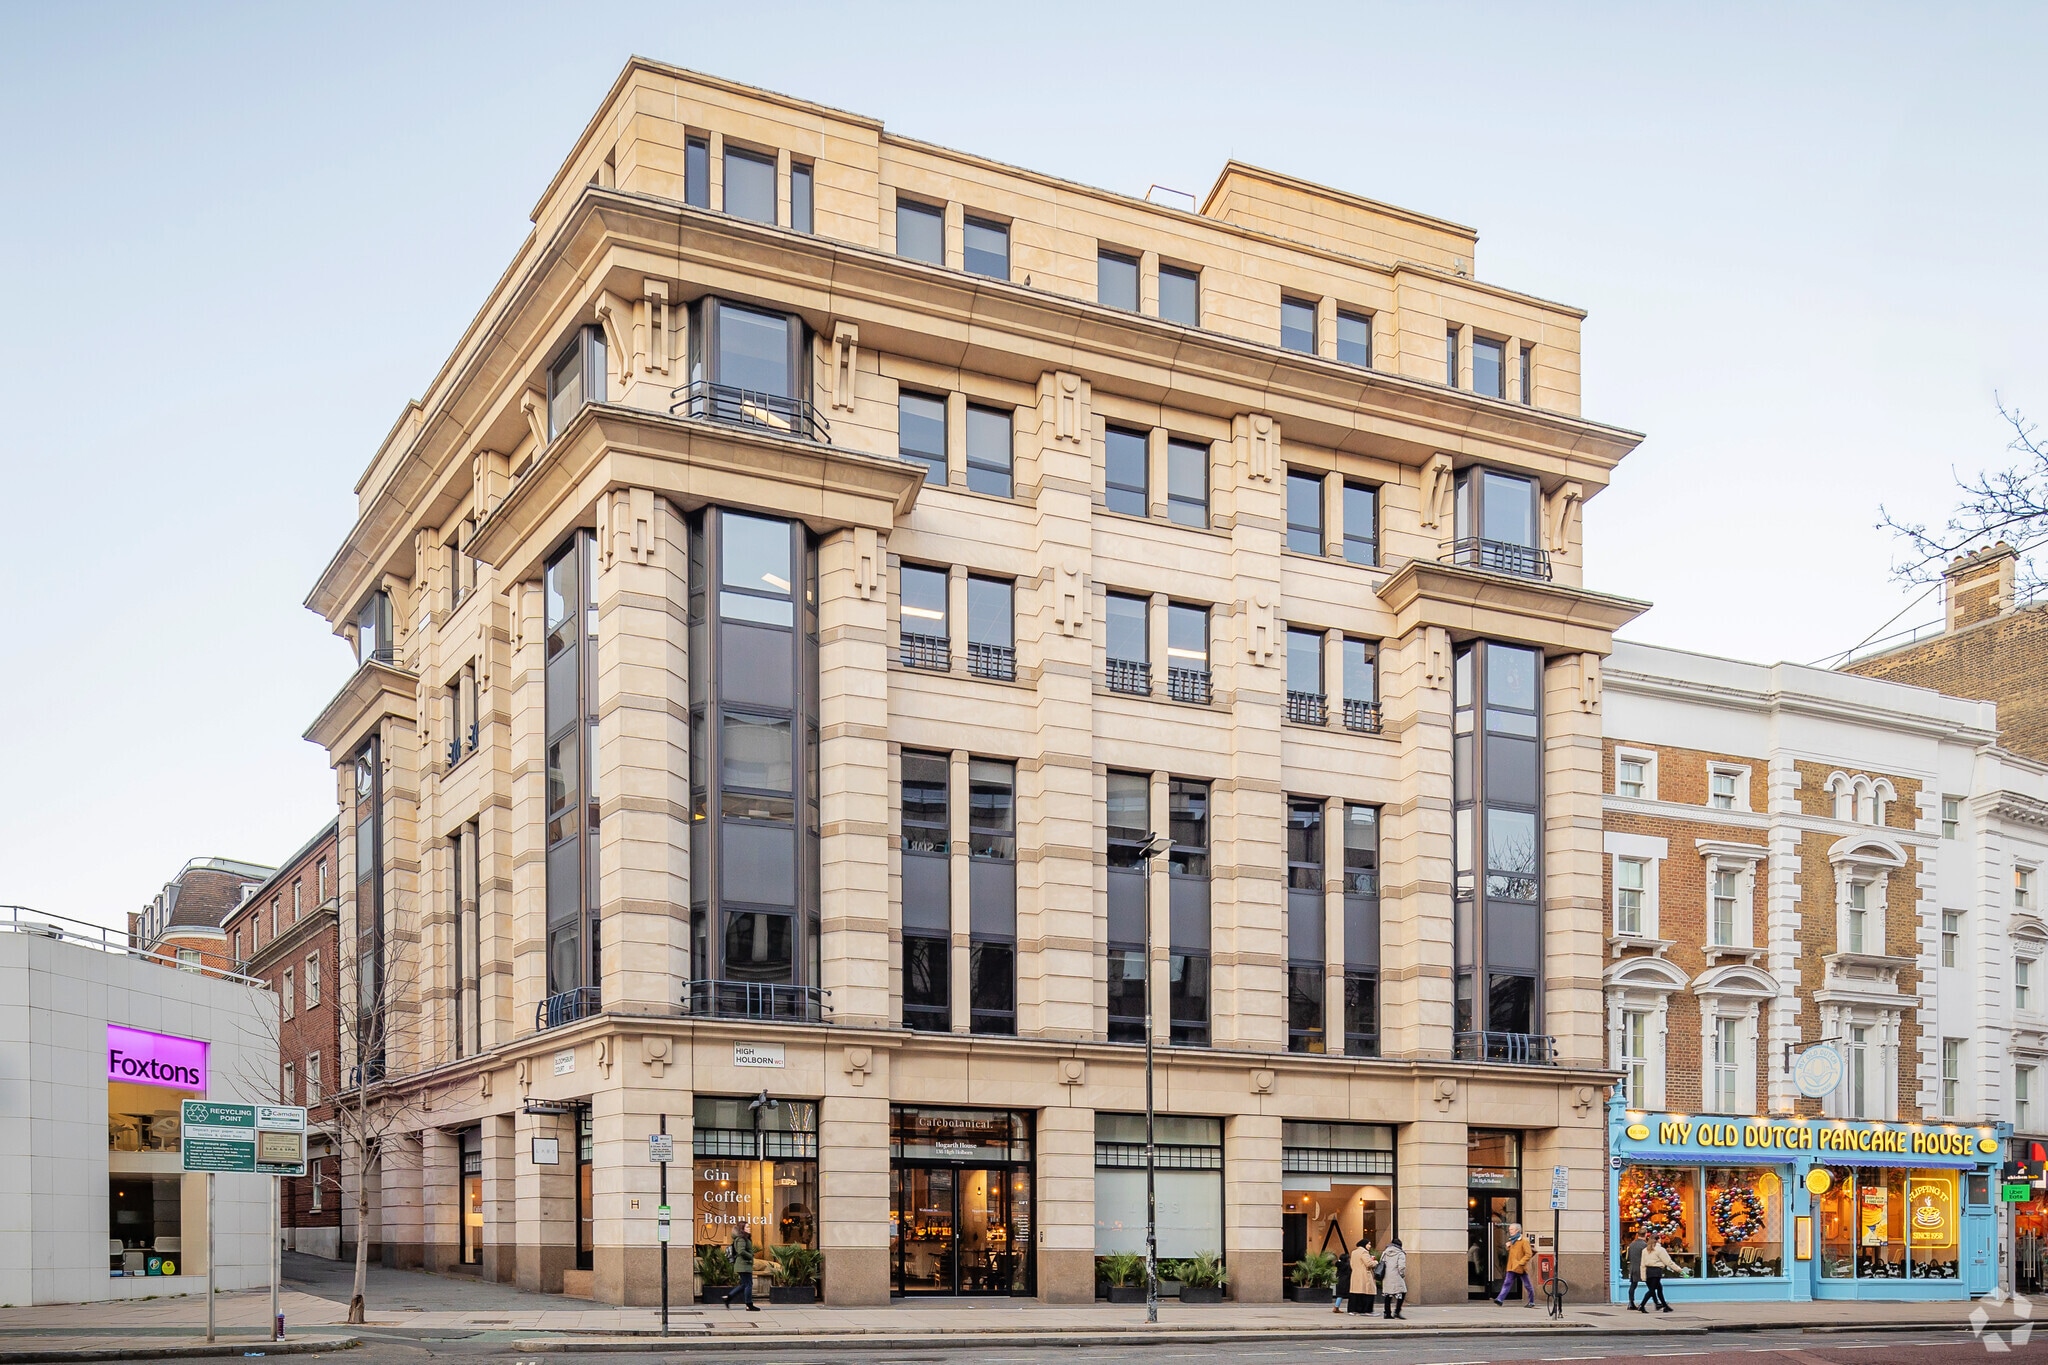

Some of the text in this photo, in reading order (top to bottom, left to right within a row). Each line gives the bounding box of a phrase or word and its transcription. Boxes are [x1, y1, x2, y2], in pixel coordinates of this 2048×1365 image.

[736, 1056, 774, 1064] HOLBORN
[1798, 1049, 1838, 1070] MY OLD DUTCH
[110, 1049, 200, 1085] Foxtons
[210, 1108, 252, 1116] RECYCLING
[1659, 1122, 1974, 1155] MY OLD DUTCH PANCAKE HOUSE
[935, 1141, 959, 1150] Hogarth
[704, 1169, 730, 1181] Gin
[704, 1191, 751, 1202] Coffee
[1908, 1185, 1949, 1203] FLIPPING IT
[1129, 1202, 1180, 1214] LBS
[705, 1213, 773, 1225] Botanical
[1912, 1231, 1943, 1240] SINCE 1958
